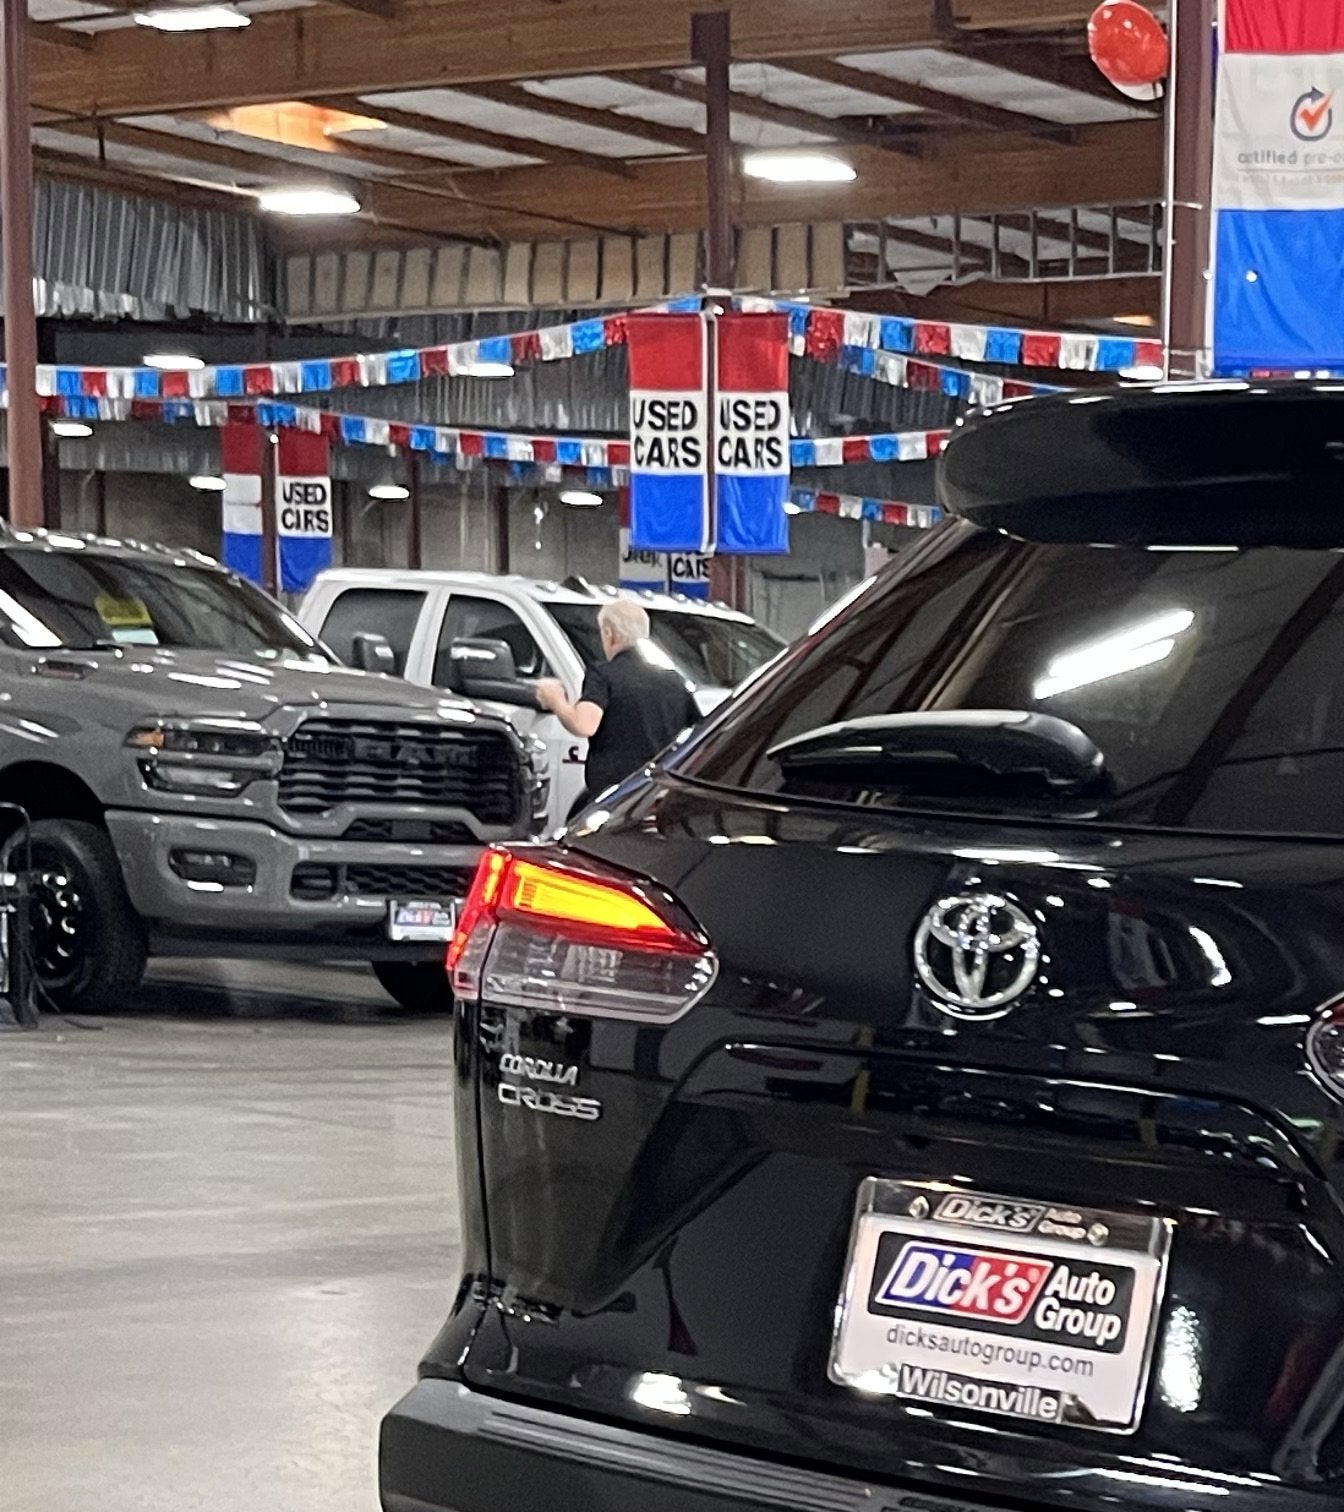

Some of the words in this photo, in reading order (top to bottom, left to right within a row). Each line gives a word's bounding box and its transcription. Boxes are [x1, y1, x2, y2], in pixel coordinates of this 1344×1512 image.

[633, 400, 698, 431] USED
[719, 400, 781, 431] USED
[634, 435, 701, 468] CARS
[718, 436, 782, 468] CARS
[282, 481, 327, 505] USED
[281, 508, 329, 532] CARS
[497, 1082, 602, 1120] CROSS
[888, 1249, 1034, 1316] Dick's
[1044, 1264, 1116, 1307] Auto
[1034, 1296, 1122, 1345] Group
[886, 1323, 1094, 1377] dicksautogroup.com
[901, 1365, 1058, 1419] Wilsonville
